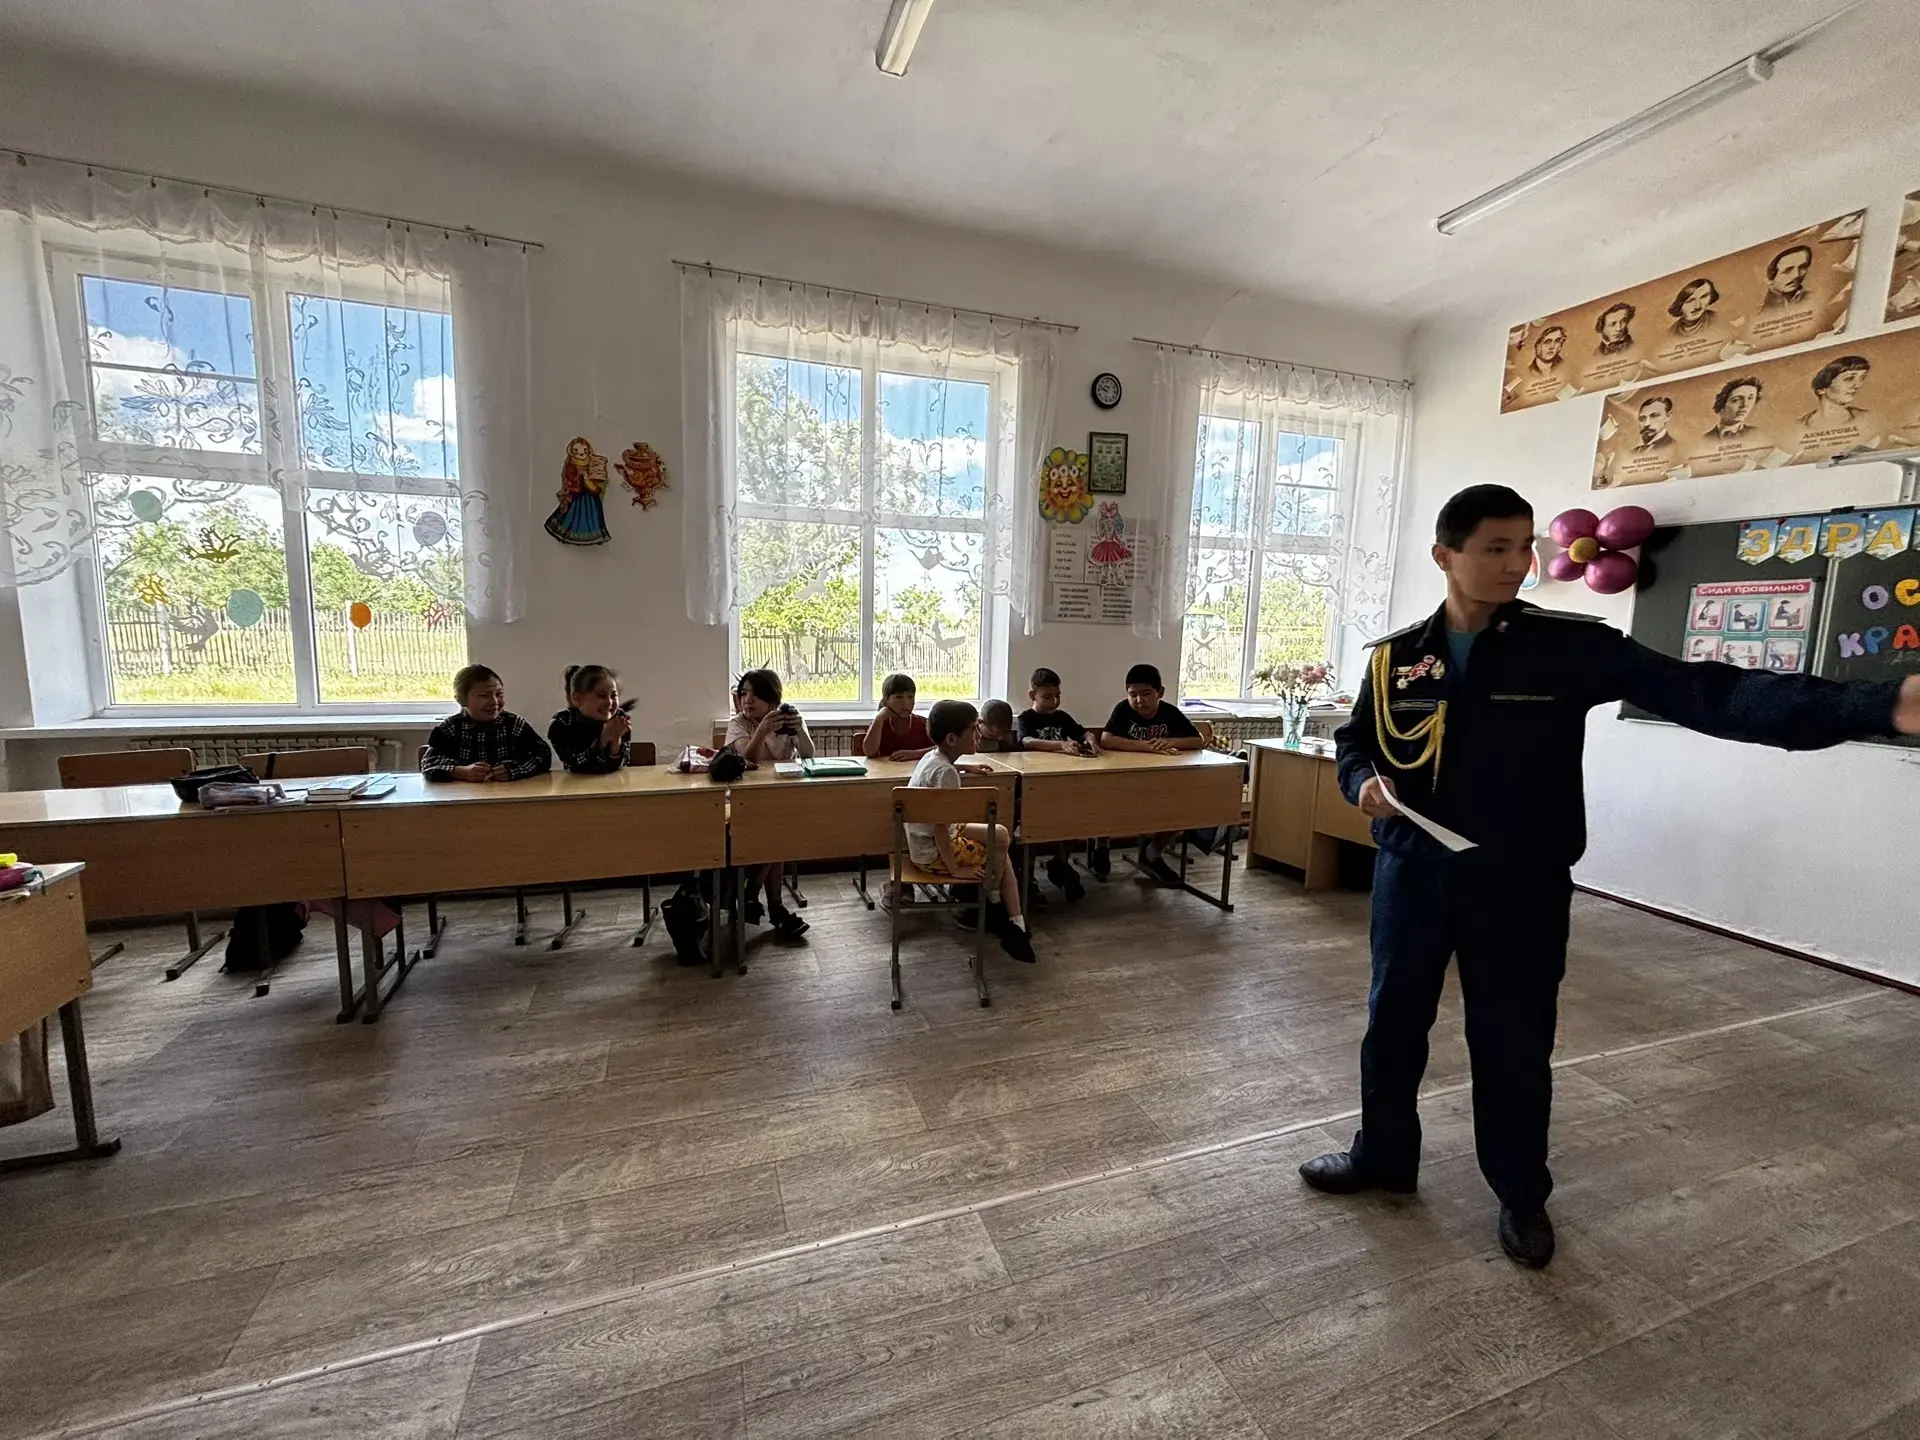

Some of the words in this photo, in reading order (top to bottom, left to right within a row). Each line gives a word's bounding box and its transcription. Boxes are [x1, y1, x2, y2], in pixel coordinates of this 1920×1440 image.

[1802, 426, 1858, 439] АХМАТОВА
[1699, 586, 1731, 595] Сиди
[1734, 584, 1805, 594] правильно
